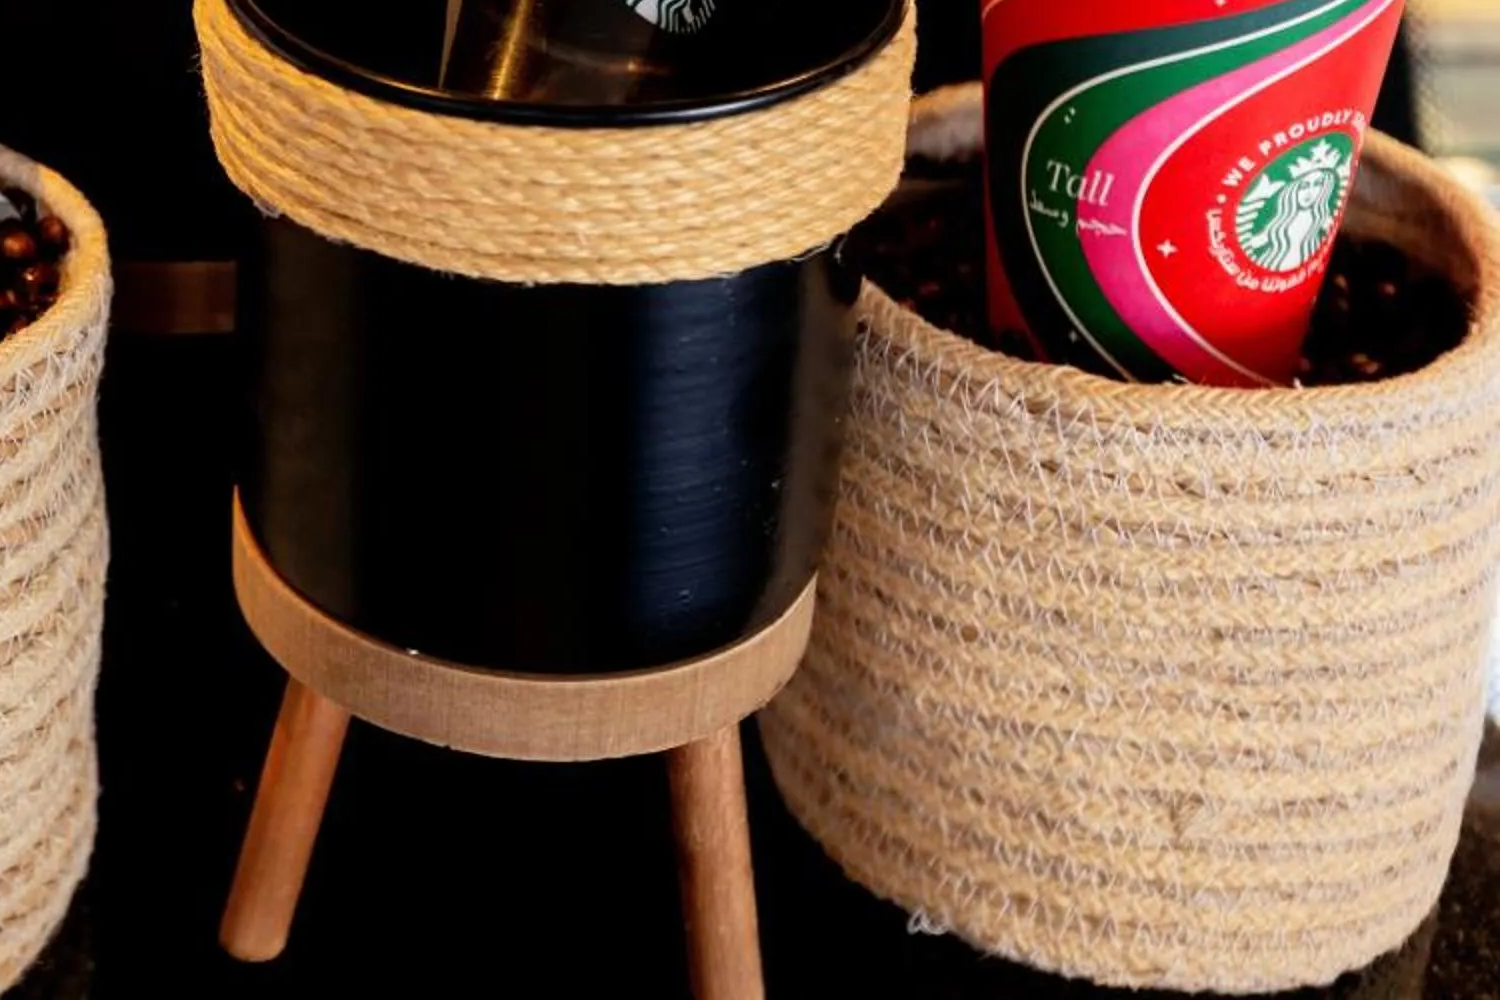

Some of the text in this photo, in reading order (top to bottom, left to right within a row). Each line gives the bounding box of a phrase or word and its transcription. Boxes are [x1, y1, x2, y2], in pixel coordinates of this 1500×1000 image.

[1221, 156, 1256, 188] WE
[1258, 109, 1352, 156] PROUDLY
[1046, 159, 1115, 207] Tall
